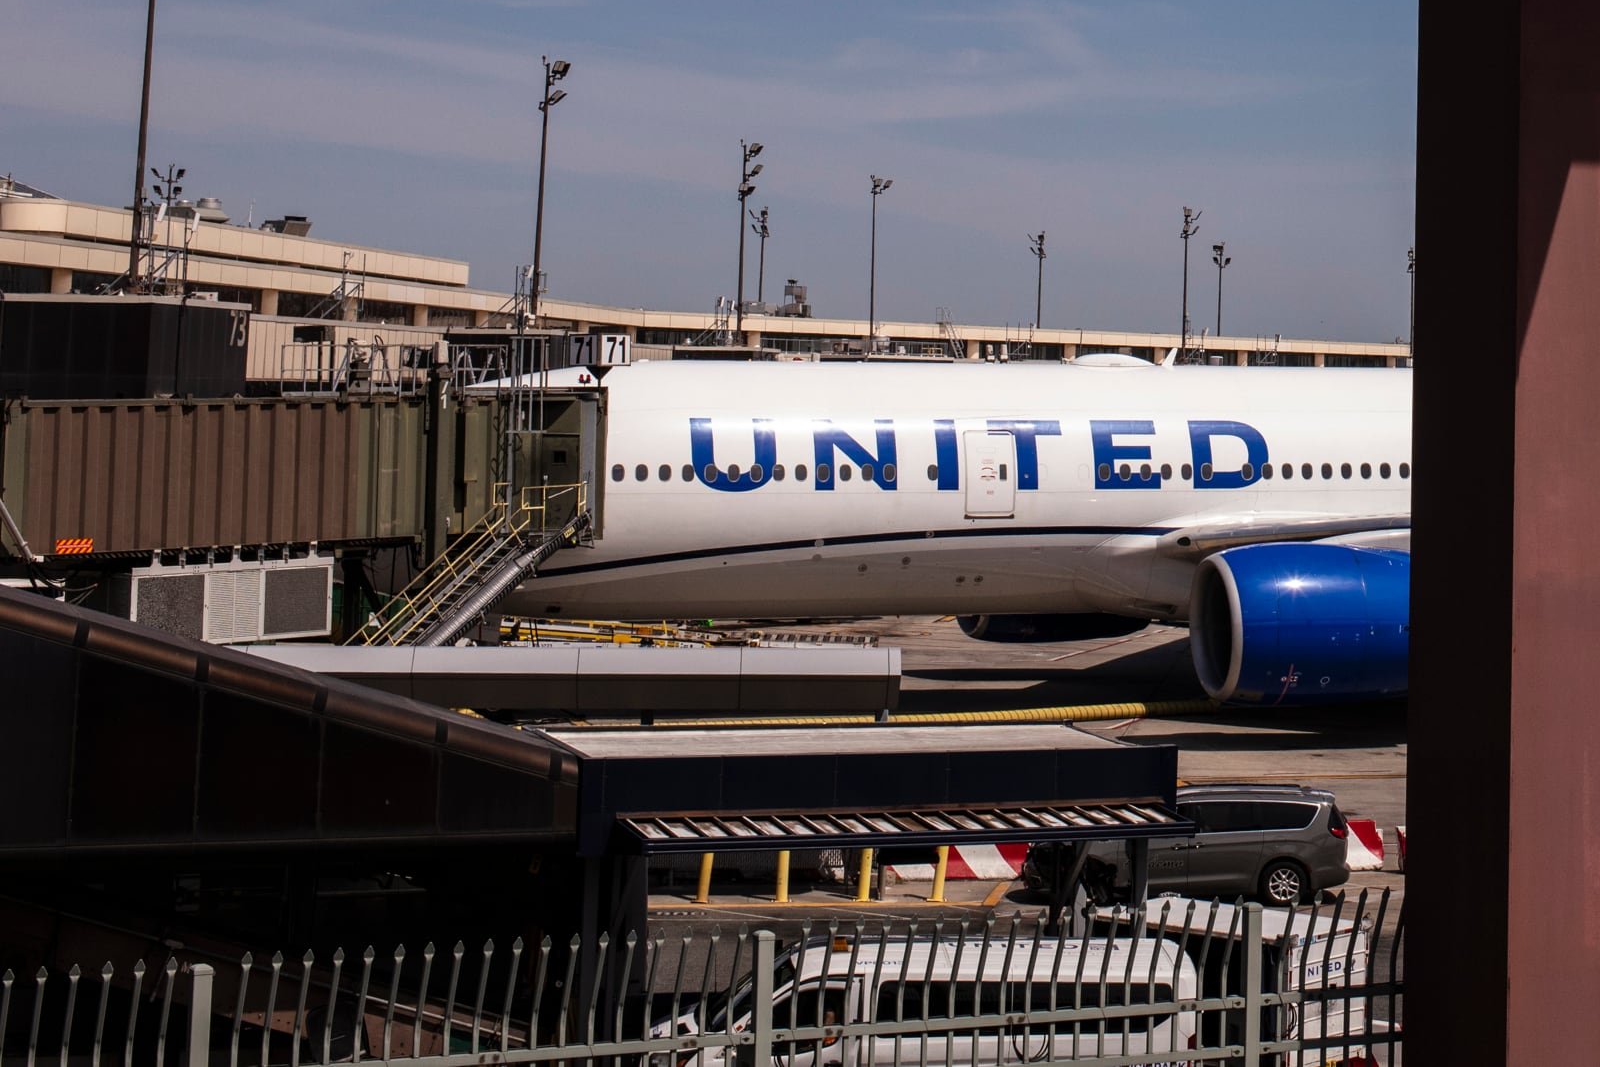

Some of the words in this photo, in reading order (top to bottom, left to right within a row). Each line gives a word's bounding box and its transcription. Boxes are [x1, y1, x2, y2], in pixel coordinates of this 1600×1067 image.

[229, 309, 247, 347] 73
[574, 337, 593, 364] 71
[606, 336, 626, 364] 71
[689, 417, 1270, 492] UNITED
[1305, 961, 1342, 977] NIED
